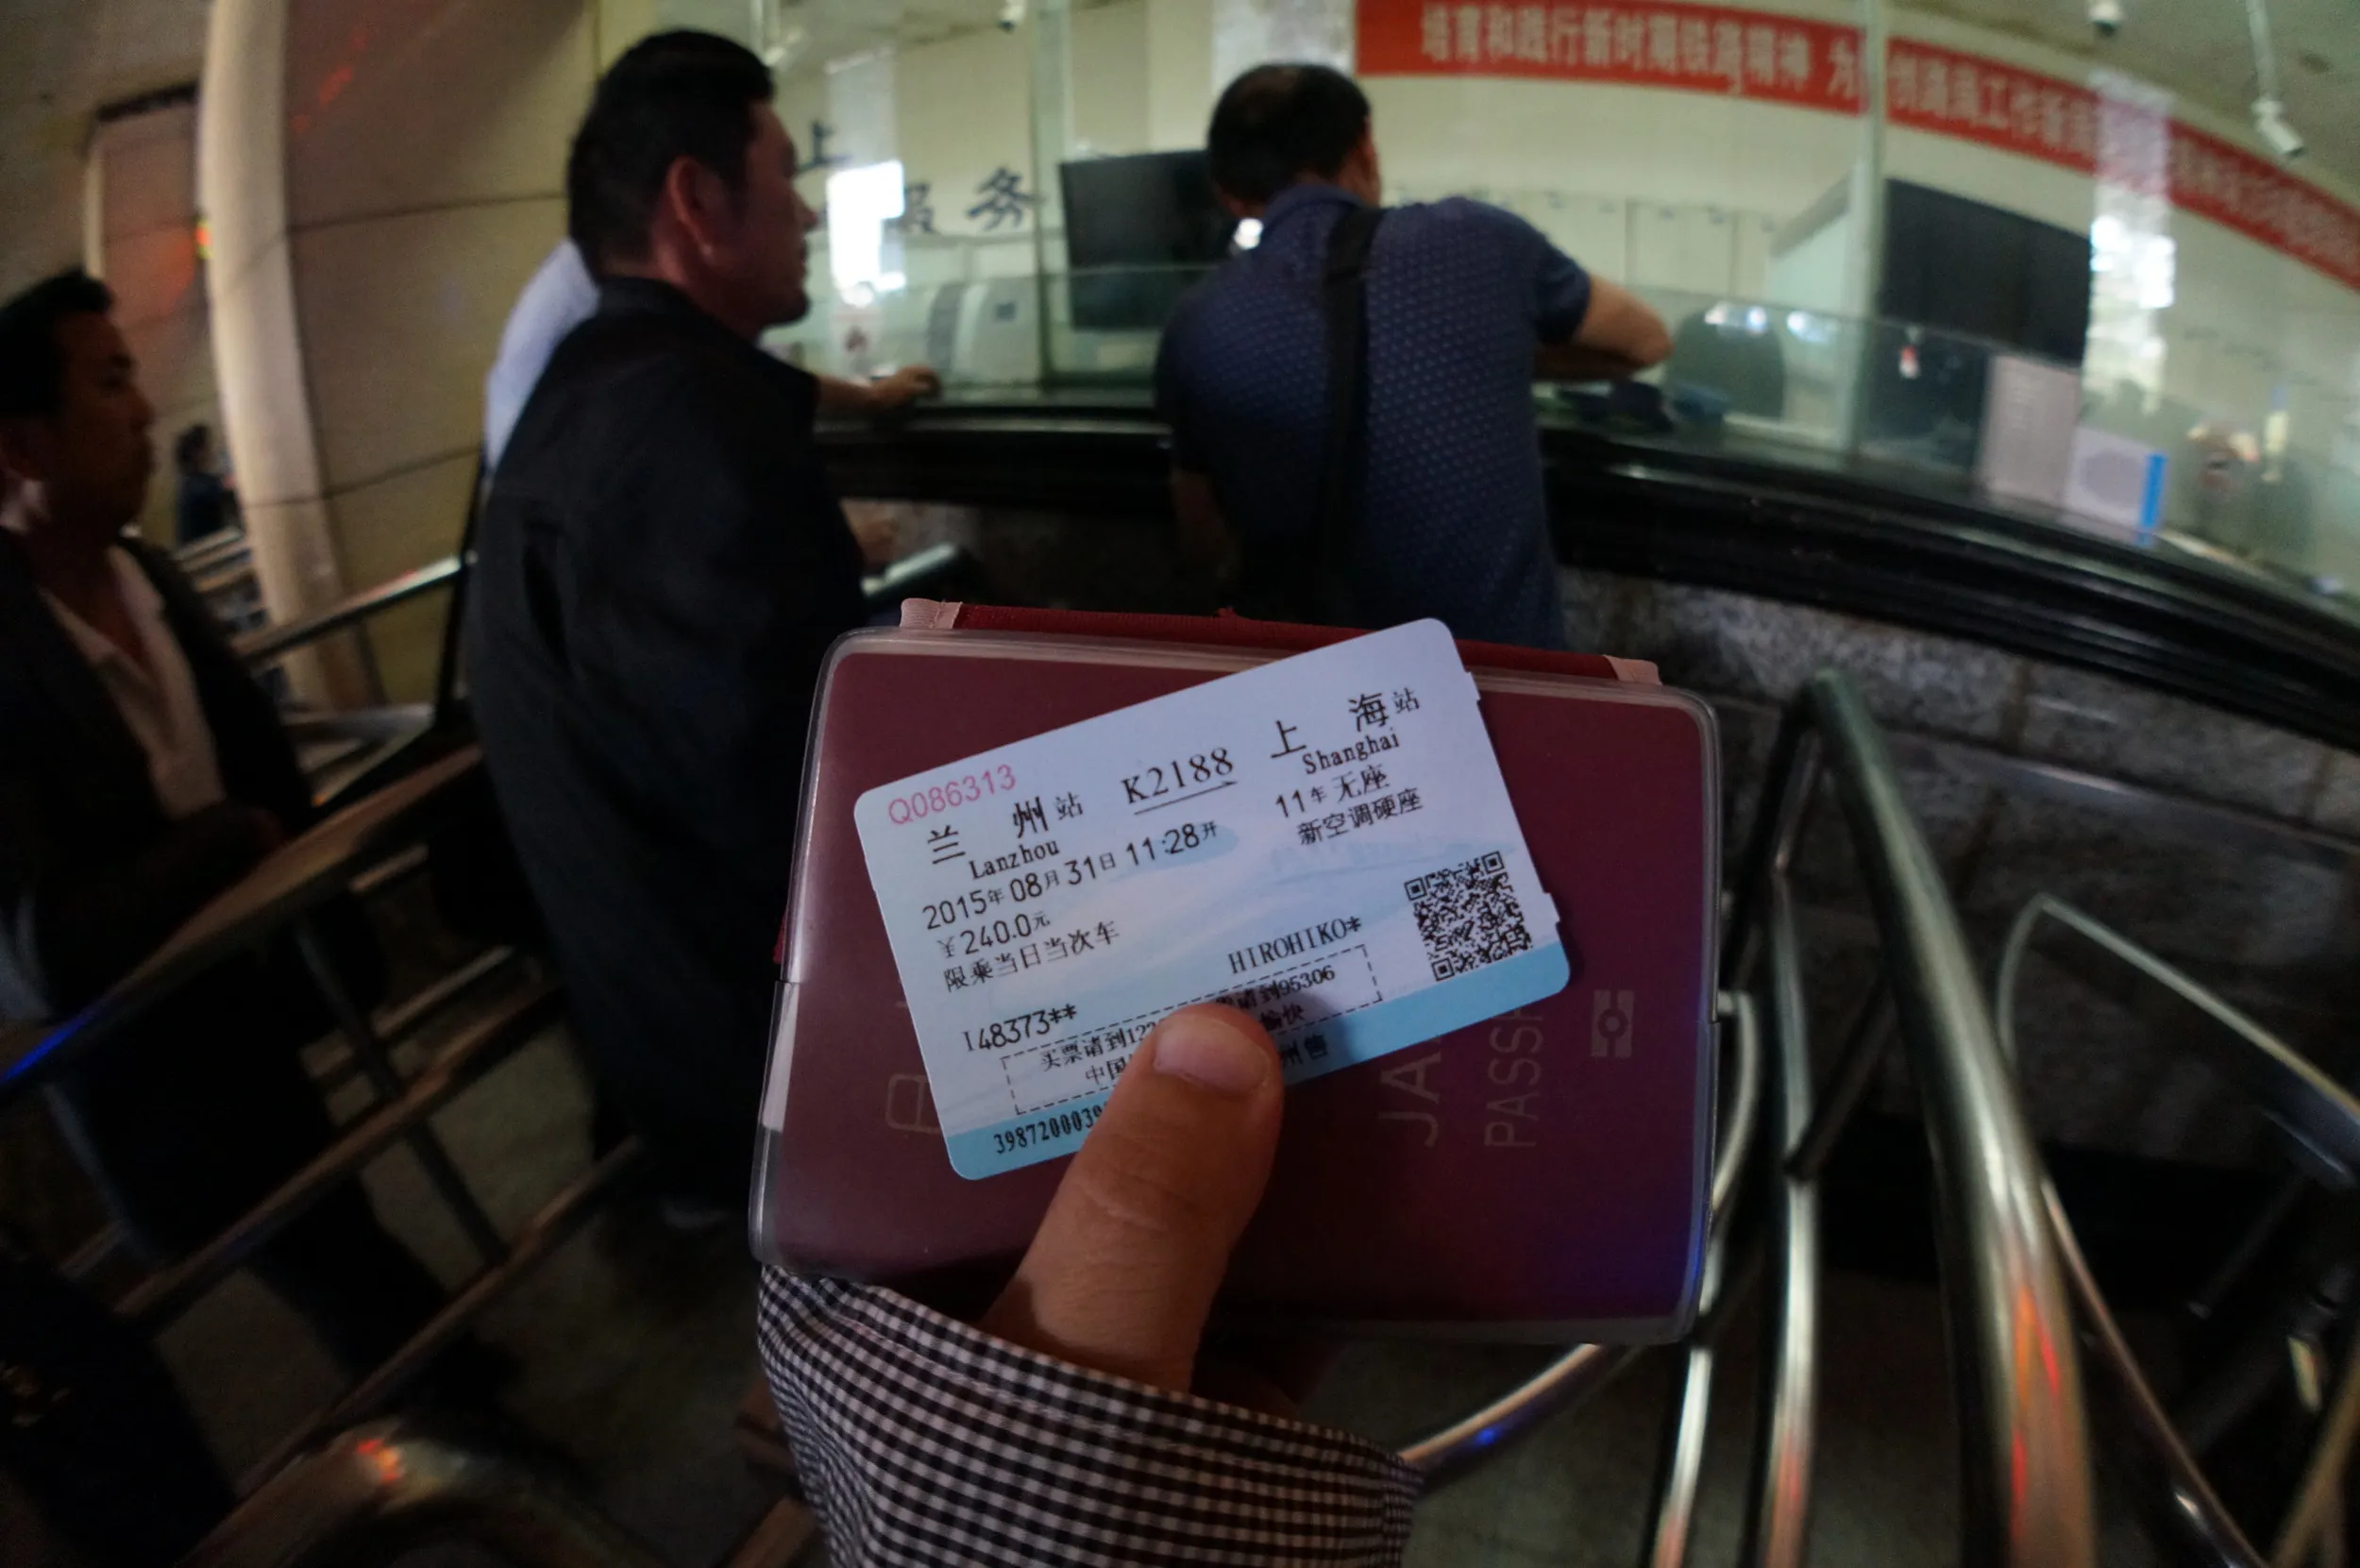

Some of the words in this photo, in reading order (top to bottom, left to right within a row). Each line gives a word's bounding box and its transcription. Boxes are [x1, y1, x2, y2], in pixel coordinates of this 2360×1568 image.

[1121, 747, 1234, 805] K2188
[1302, 728, 1400, 776] Shanghai
[888, 764, 1017, 825] Q086313
[1297, 787, 1424, 846] 新空调硬座
[969, 840, 1059, 880] Lanzhou
[944, 919, 1121, 992] 限乘当日当次车
